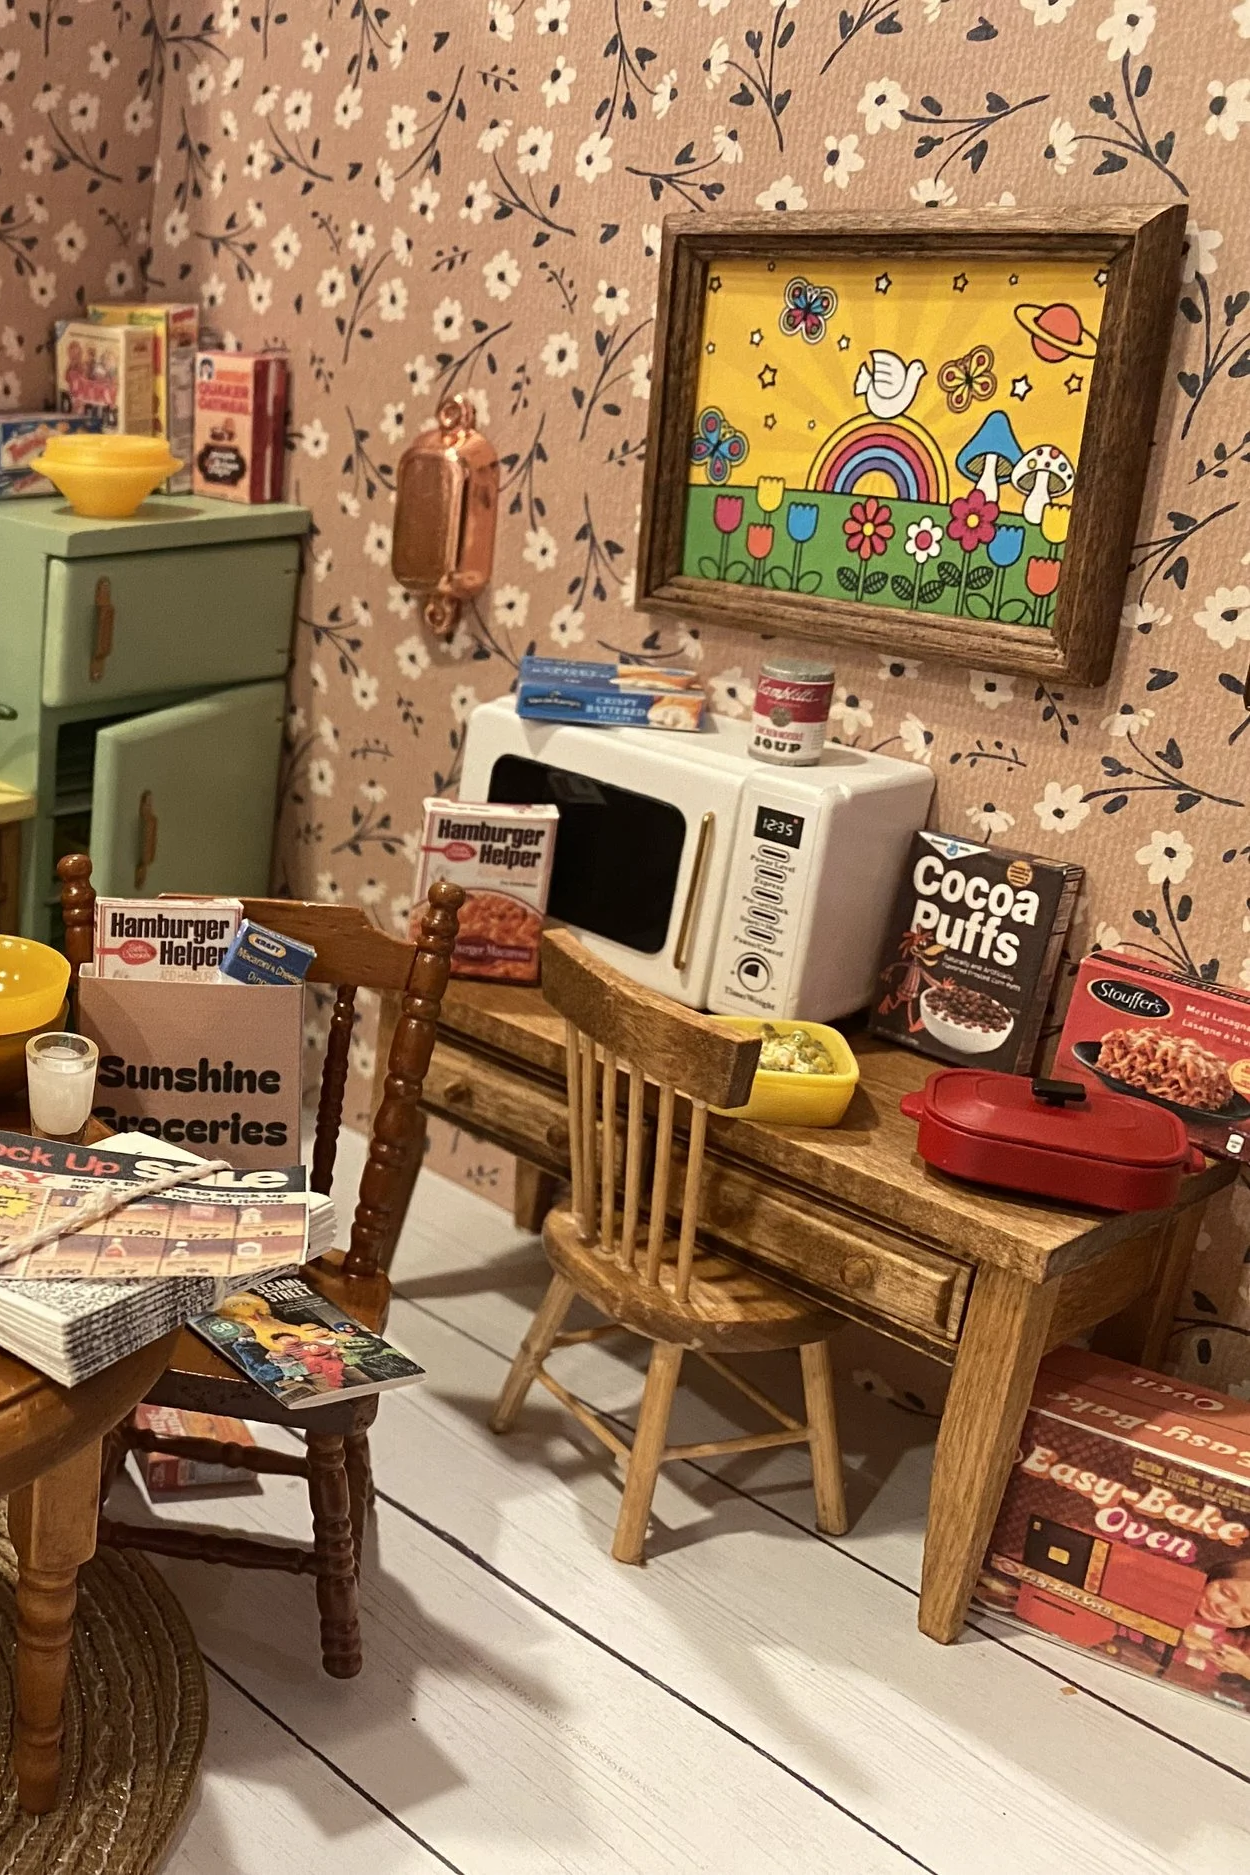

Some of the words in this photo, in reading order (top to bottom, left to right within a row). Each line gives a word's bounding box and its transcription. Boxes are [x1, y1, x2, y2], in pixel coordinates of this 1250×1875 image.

[586, 705, 646, 717] BATTERED
[596, 696, 638, 707] CRISPY
[754, 735, 802, 753] SOUP
[437, 818, 545, 848] Hamburger
[762, 817, 793, 837] 12:35
[479, 844, 542, 870] Helper
[750, 854, 773, 866] Power
[774, 862, 796, 873] Level
[754, 876, 785, 891] Express
[913, 855, 1040, 926] Cocoa
[110, 912, 230, 945] Hamburger
[910, 900, 1020, 967] Puffs
[159, 940, 226, 971] Helper
[255, 937, 281, 954] KRAFT
[237, 947, 271, 972] Macaroni
[275, 961, 303, 984] Cheese
[1098, 981, 1163, 1014] Stouffer's
[1185, 1004, 1211, 1019] Meat
[1181, 1018, 1221, 1039] Lasagne
[97, 1055, 281, 1095] Sunshine
[65, 1152, 121, 1177] Up
[71, 1177, 116, 1188] now's
[215, 1191, 260, 1200] stock
[265, 1193, 289, 1201] up
[171, 1194, 233, 1204] needed
[237, 1197, 284, 1206] items
[184, 1231, 221, 1240] 1.77
[256, 1278, 307, 1295] SESAME
[264, 1285, 314, 1303] STREET
[211, 1322, 233, 1333] 50
[1130, 1376, 1226, 1412] Oven
[1019, 1445, 1249, 1544] Easy-Bake
[1094, 1506, 1197, 1563] Oven
